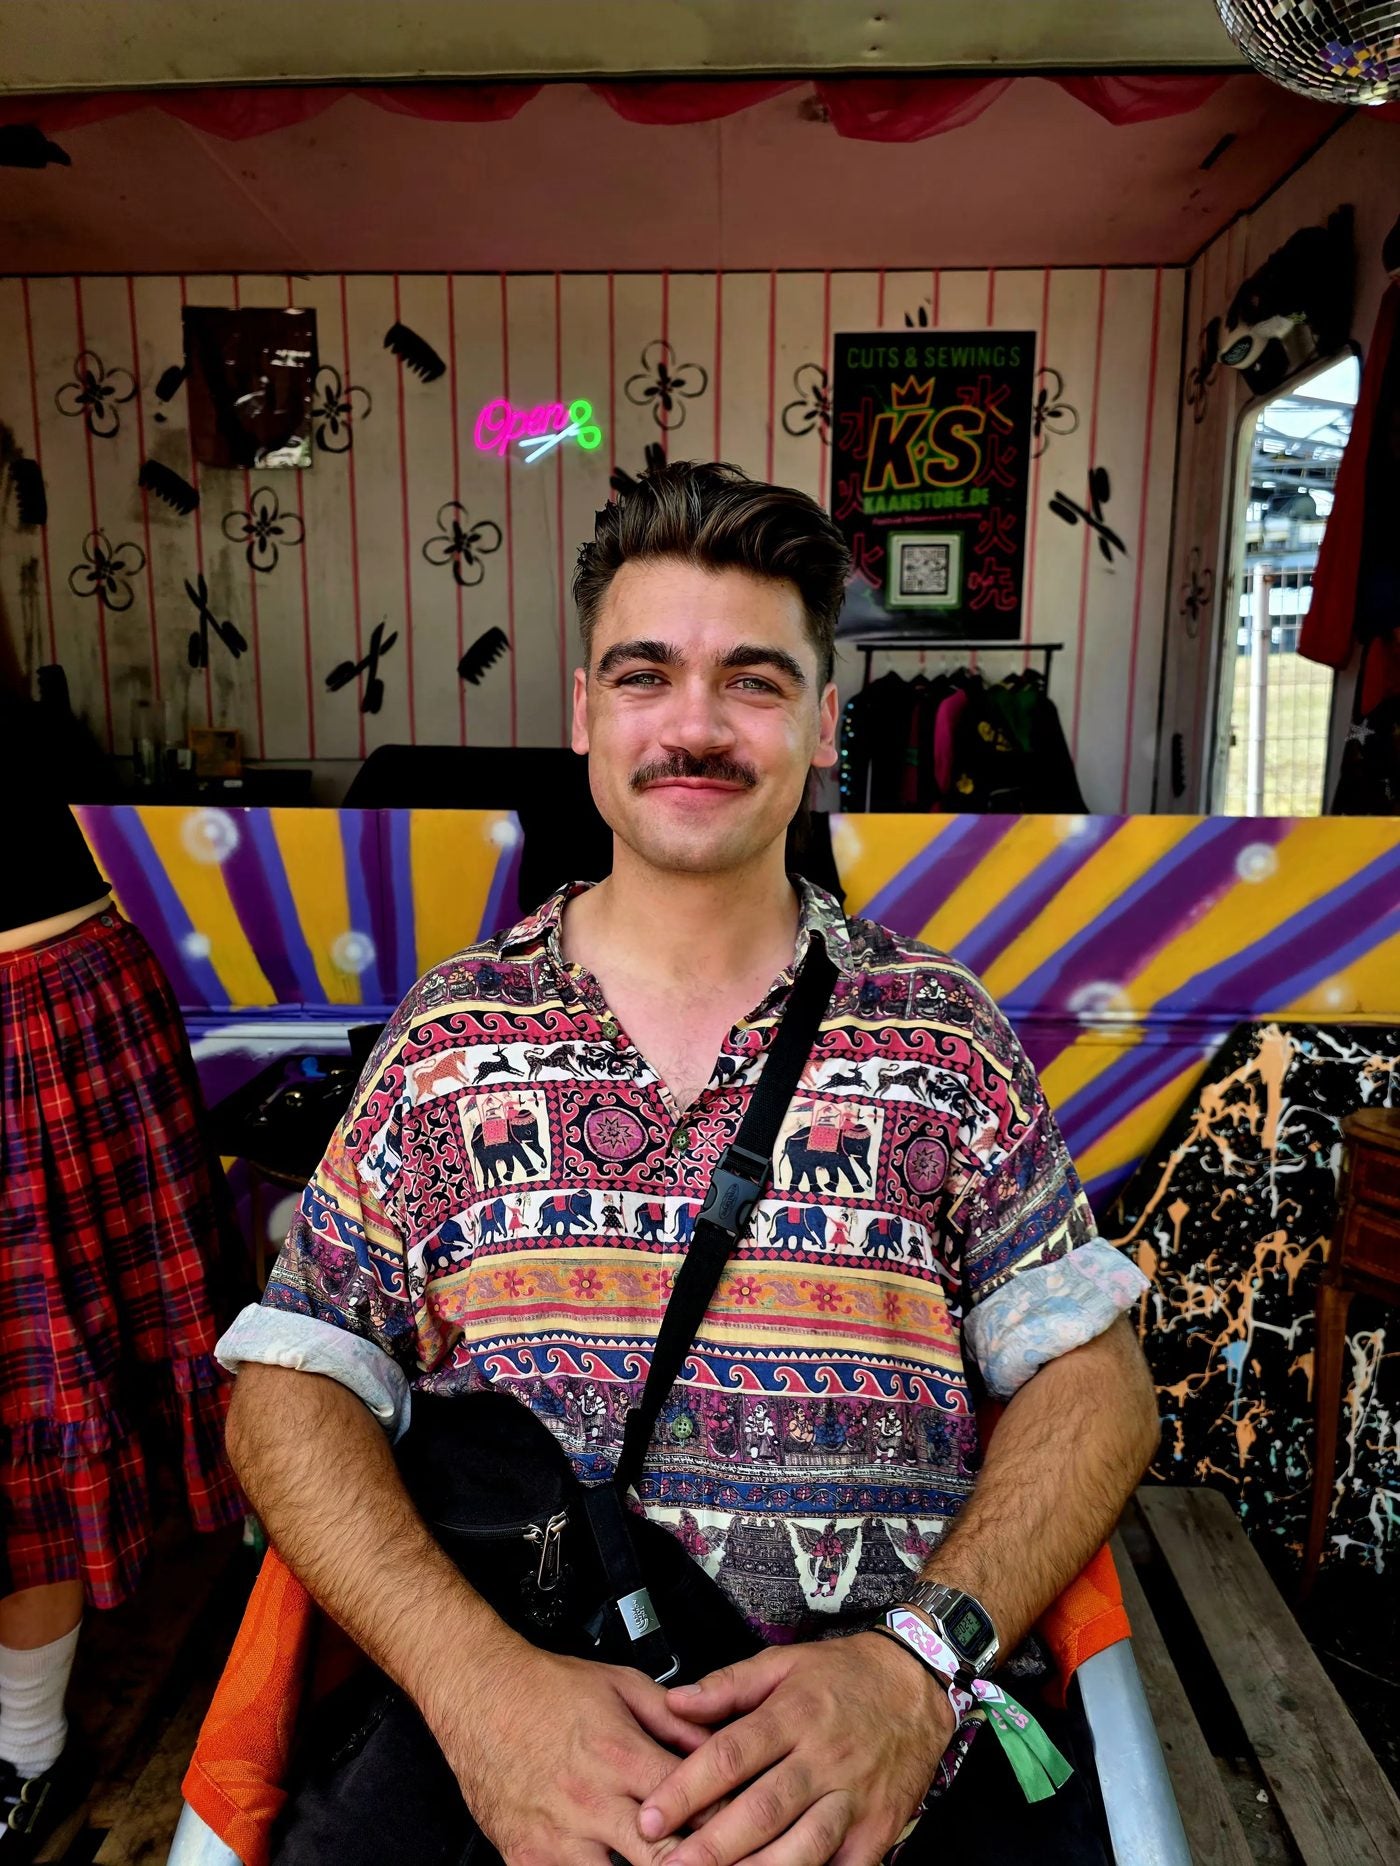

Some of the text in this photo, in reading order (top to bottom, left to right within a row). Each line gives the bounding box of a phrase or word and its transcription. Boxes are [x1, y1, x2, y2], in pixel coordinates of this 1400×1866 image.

[847, 346, 1021, 368] CUTS & SEWINGS
[474, 398, 570, 456] Open
